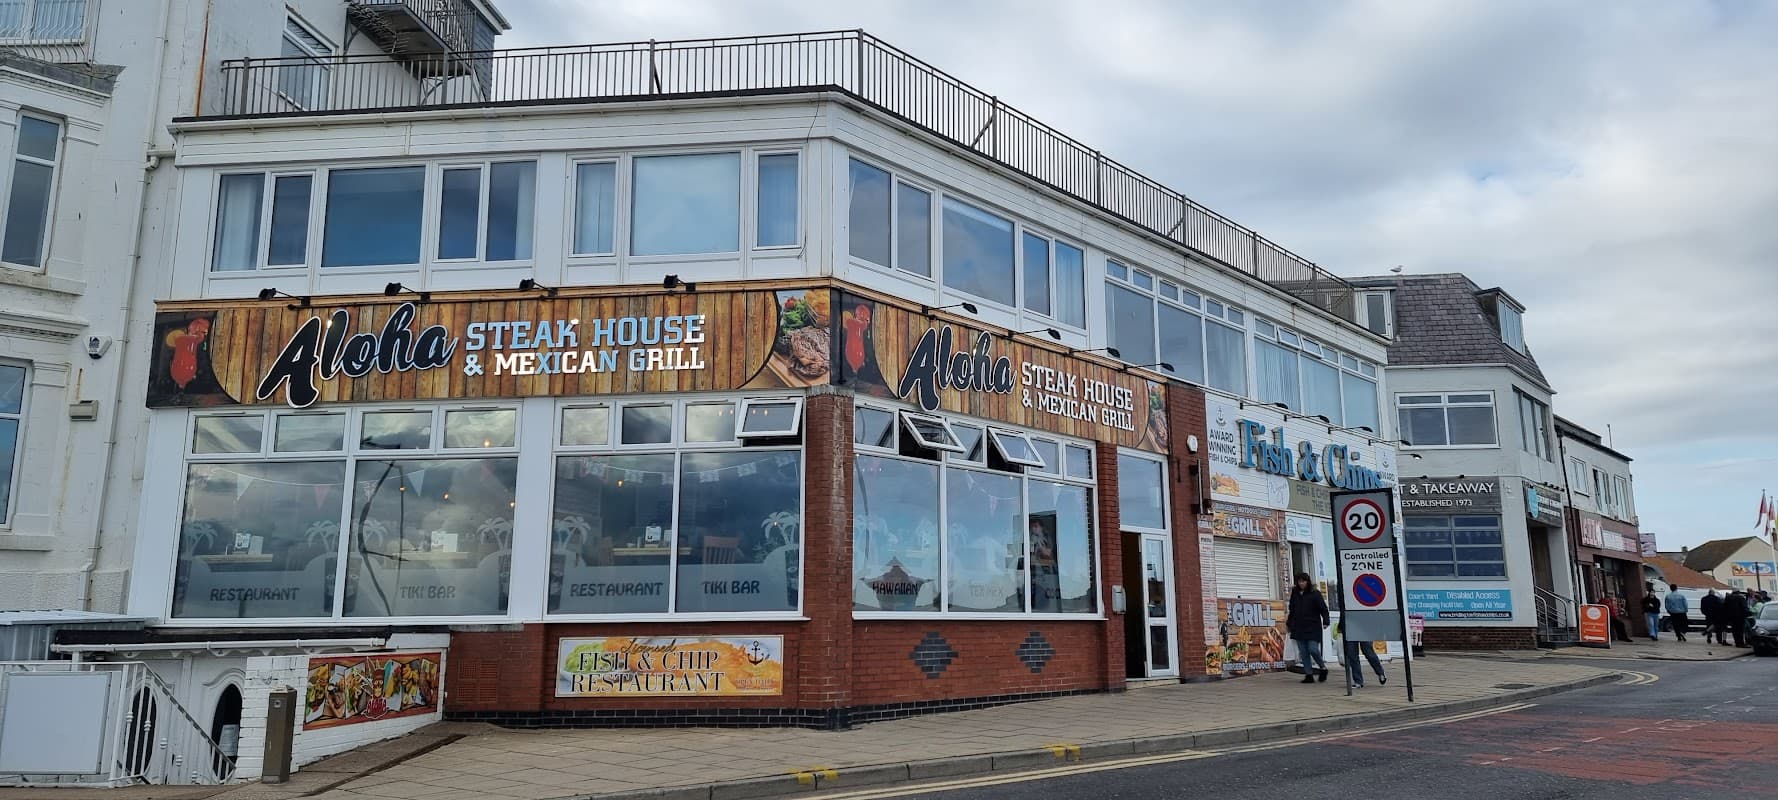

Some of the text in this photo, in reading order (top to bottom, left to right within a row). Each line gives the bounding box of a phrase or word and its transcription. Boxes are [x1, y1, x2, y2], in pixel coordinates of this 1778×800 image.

[466, 314, 705, 350] STEAK HOUSE
[257, 303, 457, 408] Aloha
[463, 346, 705, 376] & MEXICAN GRILL
[899, 325, 1018, 411] Aloha
[1021, 361, 1134, 412] STEAK HOUSE
[1021, 389, 1135, 431] & MEXICAN GRILL
[1209, 429, 1234, 443] AWARD
[1208, 441, 1236, 455] WINNING
[1237, 419, 1295, 476] Fish
[1298, 440, 1323, 482] &
[1208, 453, 1219, 462] FISH
[1224, 456, 1238, 466] CHIPS
[1410, 483, 1419, 494] &
[1421, 482, 1495, 495] TAKEAWAY
[1231, 517, 1264, 536] GRILL
[1348, 511, 1379, 530] 20
[1344, 551, 1389, 560] Controlled
[1351, 561, 1384, 571] ZONE
[210, 587, 300, 601] RESTAURANT
[400, 585, 456, 599] TIKI BAR
[570, 582, 664, 597] RESTAURANT
[703, 580, 760, 595] TIKI BAR
[873, 582, 919, 596] HAWAIIAN
[1475, 591, 1500, 600] Access
[1233, 602, 1276, 626] GRILL
[579, 650, 719, 671] FISH & CHIP
[570, 671, 725, 693] RESTAURANT
